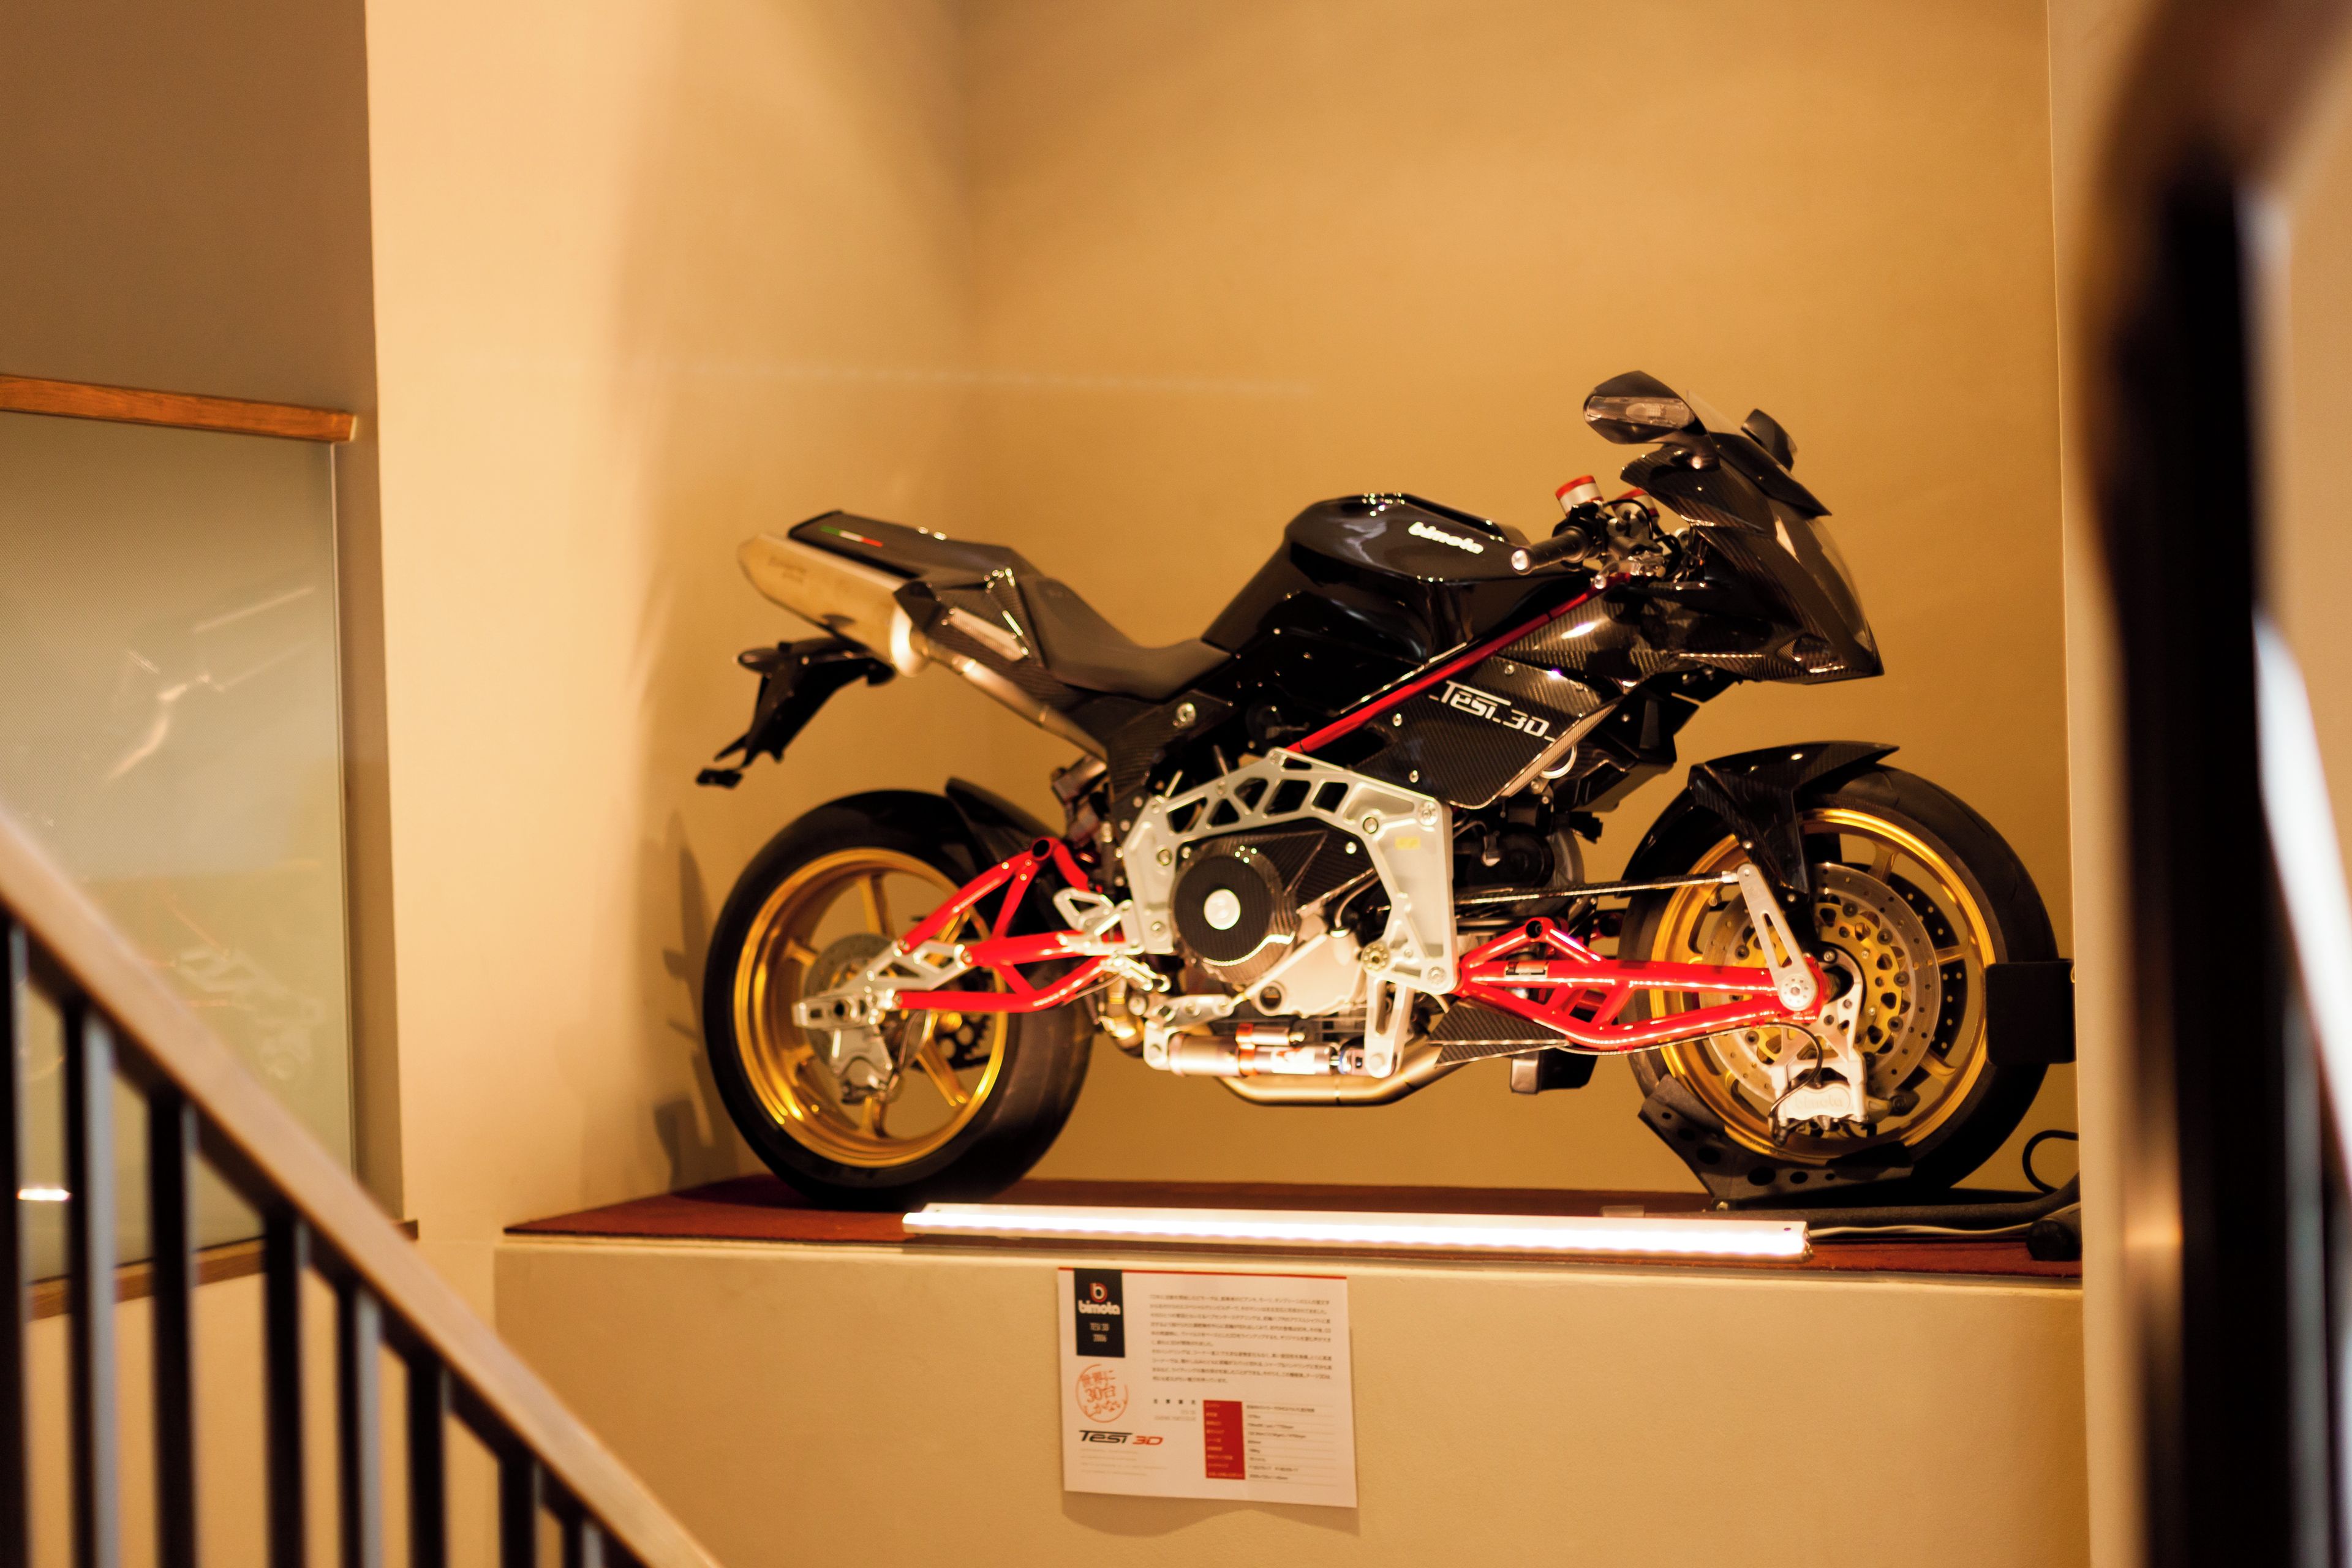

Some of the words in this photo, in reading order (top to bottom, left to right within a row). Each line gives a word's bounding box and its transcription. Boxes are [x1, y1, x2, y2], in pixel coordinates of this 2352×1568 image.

[1408, 521, 1484, 554] bimota
[1502, 709, 1550, 737] 3D
[1078, 1299, 1121, 1315] bimota
[1133, 1436, 1163, 1446] 3D
